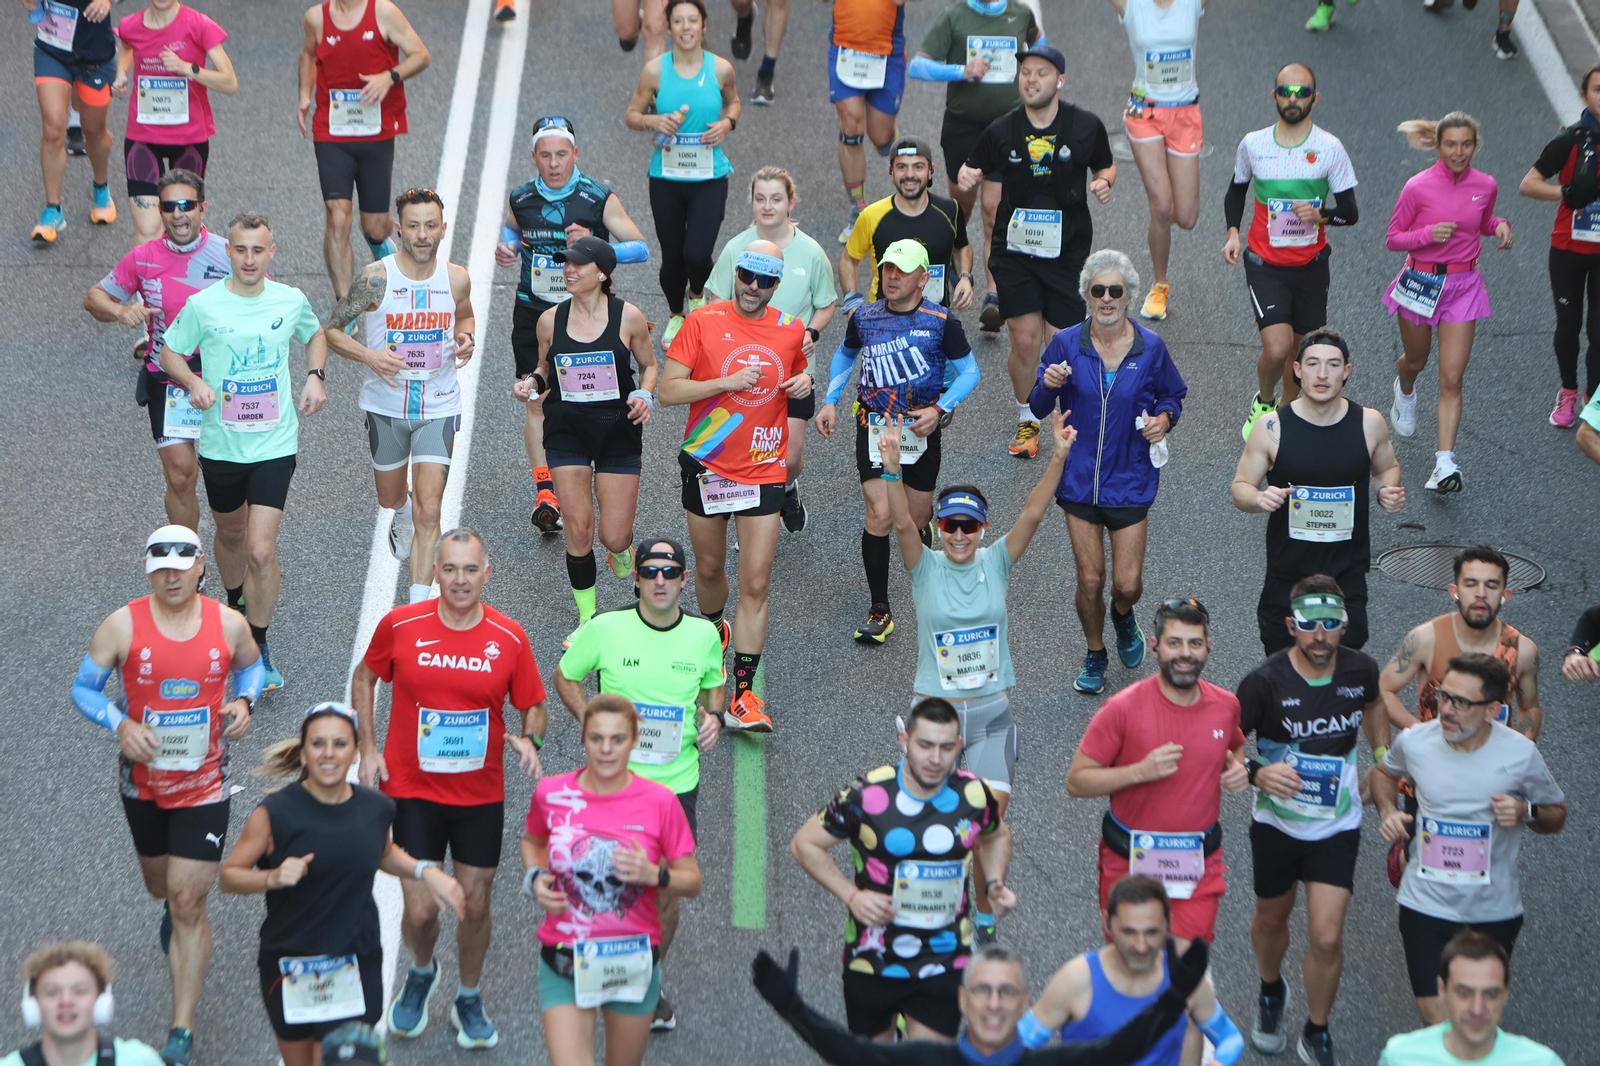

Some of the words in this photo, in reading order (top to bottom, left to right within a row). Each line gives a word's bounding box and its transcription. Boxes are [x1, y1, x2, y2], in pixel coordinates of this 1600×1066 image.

[985, 40, 1011, 48] ZURICH
[1162, 52, 1187, 60] ZURICH
[153, 80, 181, 88] ZURICH
[677, 152, 698, 160] 10804
[1028, 213, 1055, 222] ZURICH
[1024, 229, 1044, 237] 10191
[550, 275, 564, 283] 972
[386, 312, 452, 331] MADRID
[407, 333, 437, 341] ZURICH
[909, 329, 931, 338] HOKA
[870, 336, 909, 359] MARATÓN
[407, 350, 425, 358] 7635
[575, 355, 608, 366] ZURICH
[577, 373, 596, 381] 7244
[240, 382, 272, 393] ZURICH
[240, 402, 260, 410] 7537
[237, 413, 264, 421] LORDEN
[752, 426, 783, 441] RUN
[751, 439, 782, 453] NING
[749, 446, 781, 463] Team
[726, 489, 755, 499] CARLOTA
[1312, 491, 1346, 499] ZURICH
[1309, 509, 1334, 518] 10022
[1305, 521, 1337, 529] STEPHEN
[958, 630, 990, 643] ZURICH
[623, 657, 641, 667] IAN
[958, 652, 982, 662] 10836
[417, 652, 492, 673] CANADA
[671, 665, 698, 673] WOLFPACK
[957, 665, 986, 675] MARIAM
[164, 682, 196, 695] L'aire
[640, 708, 676, 719] ZURICH
[163, 713, 201, 726] ZURICH
[444, 714, 480, 725] ZURICH
[640, 728, 661, 737] 0260
[443, 736, 464, 745] 3691
[640, 741, 653, 749] IAN
[436, 749, 470, 757] JACQUES
[1301, 758, 1337, 772] ZURICH
[1441, 821, 1482, 837] ZURICH
[1158, 838, 1196, 849] ZURICH
[922, 864, 957, 876] ZURICH
[603, 941, 641, 953] ZURICH
[307, 956, 346, 971] ZURICH
